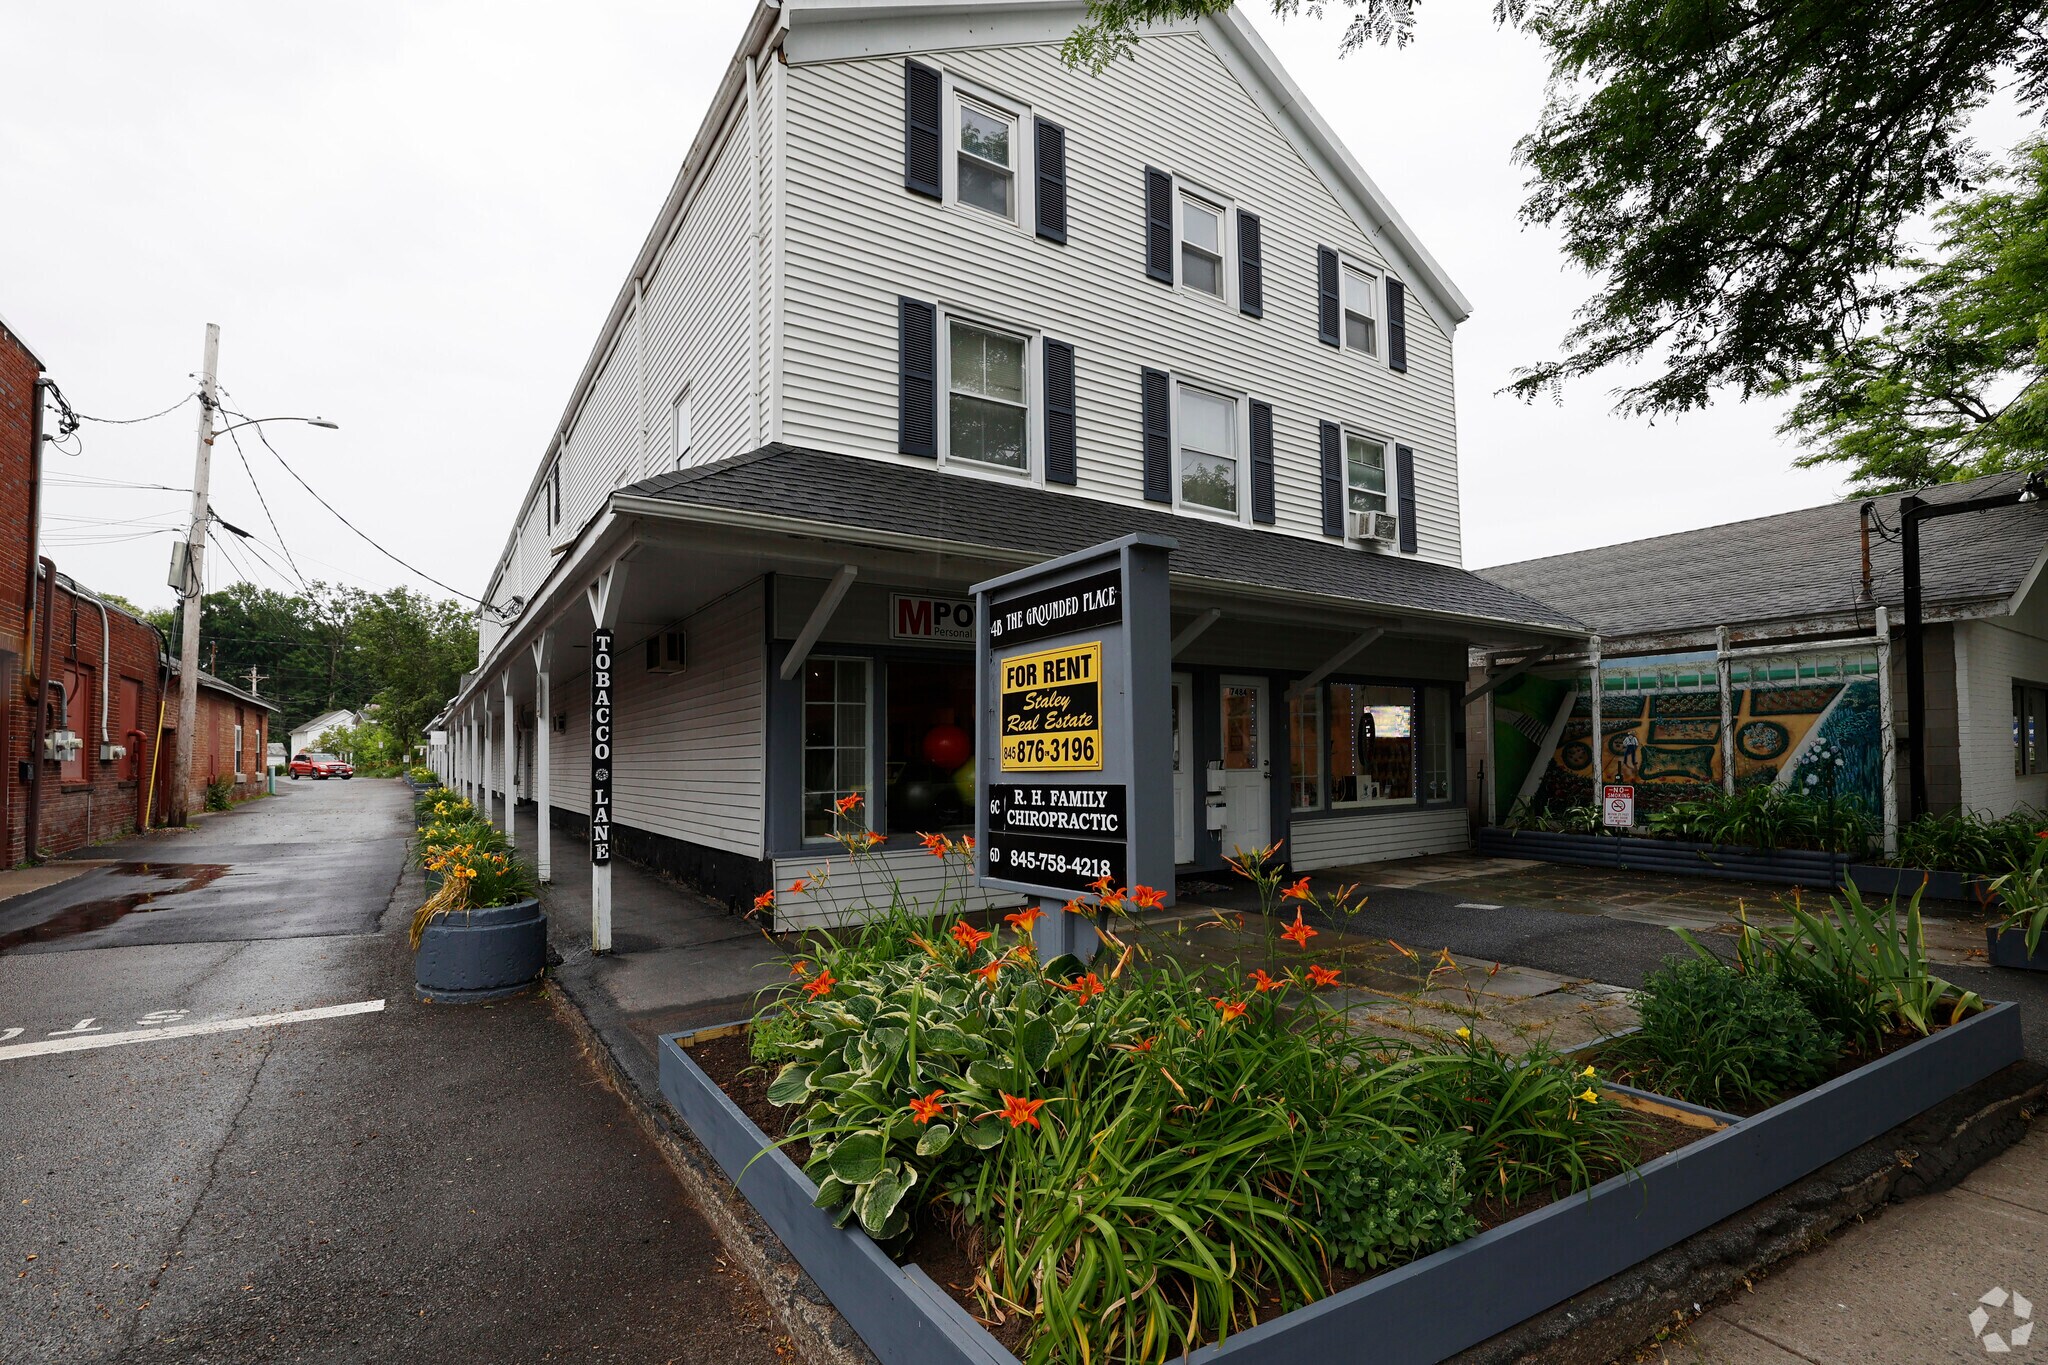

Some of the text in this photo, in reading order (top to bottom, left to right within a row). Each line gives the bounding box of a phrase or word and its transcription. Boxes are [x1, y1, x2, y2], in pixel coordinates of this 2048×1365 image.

[899, 598, 976, 636] MPO
[990, 586, 1116, 637] 4B THE GROUNDED PLACE
[934, 626, 972, 638] Personal
[1007, 653, 1092, 689] FOR RENT
[595, 636, 611, 760] TOBACCO
[1023, 690, 1071, 712] Staley
[1007, 710, 1093, 733] Real Estate
[1004, 746, 1016, 760] 845
[990, 799, 1000, 814] 6C
[1014, 789, 1108, 808] R. H. FAMILY
[593, 789, 609, 860] LANE
[1007, 809, 1118, 832] CHIROPRACTIC
[990, 847, 1000, 863] 6D
[1010, 849, 1111, 877] 845-758-4218
